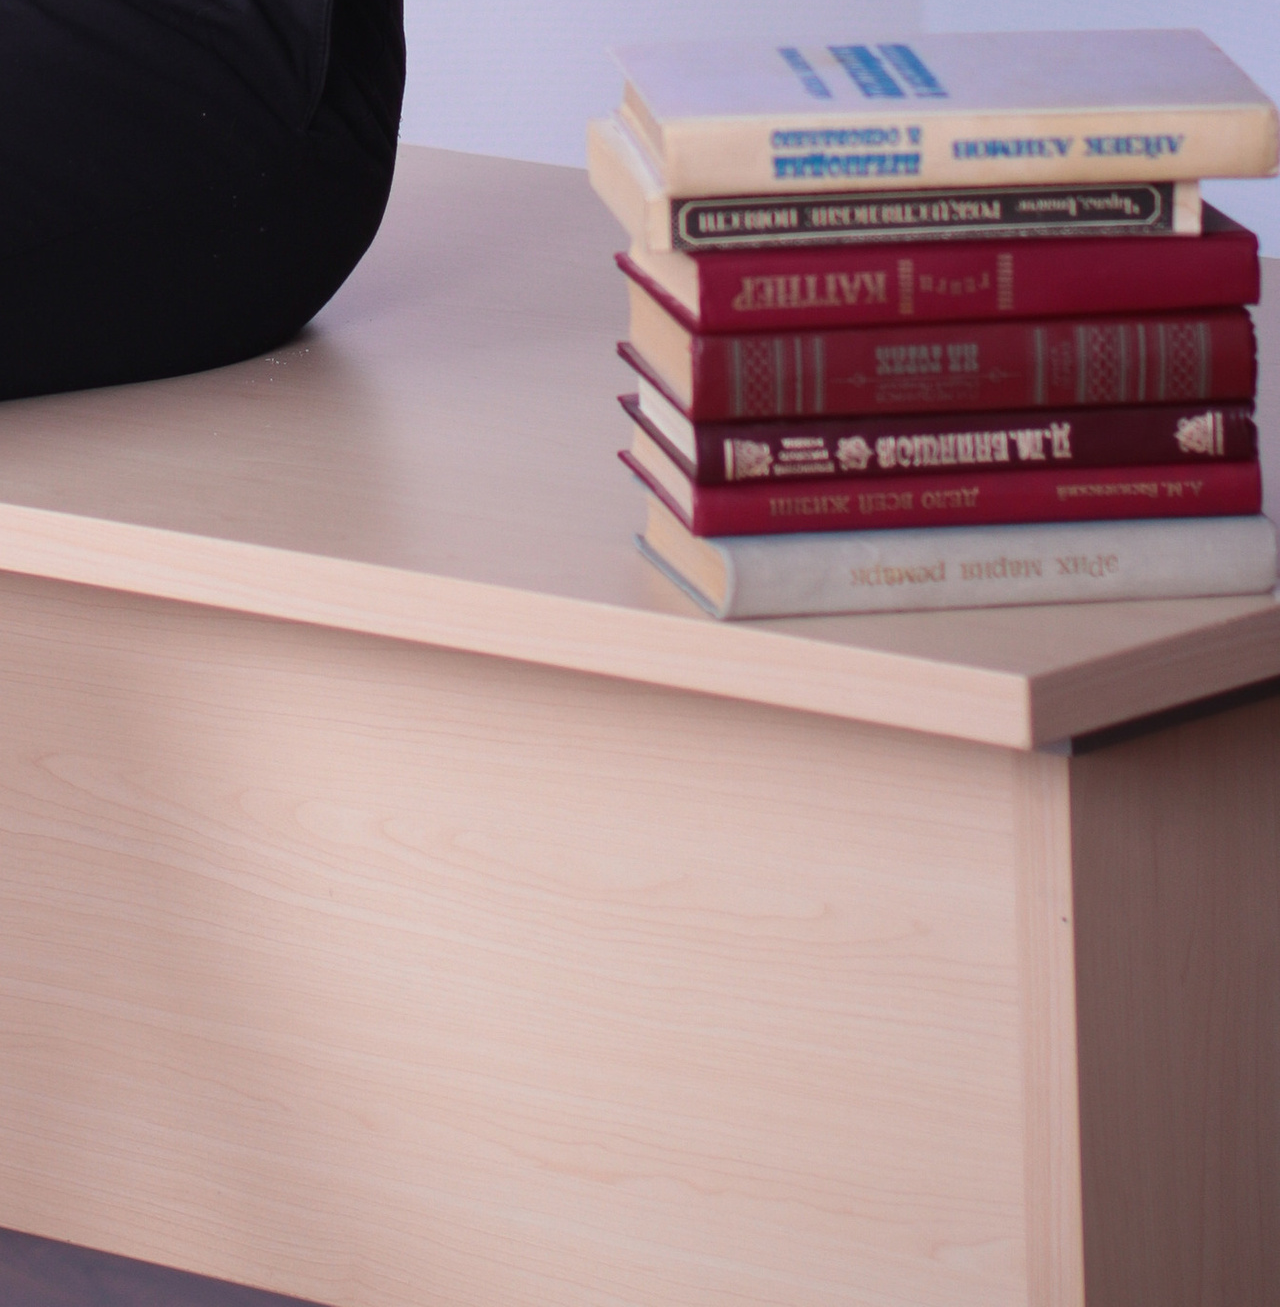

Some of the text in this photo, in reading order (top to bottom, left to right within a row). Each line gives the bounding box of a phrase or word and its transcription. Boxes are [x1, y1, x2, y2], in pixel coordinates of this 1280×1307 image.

[952, 133, 1184, 161] АЙЗЕК АЗИМОВ
[732, 270, 889, 312] КАТТНЕР
[768, 494, 851, 517] ЖИЗНИ
[857, 490, 915, 515] ВСЕЙ
[920, 485, 980, 511] ДЕЛО
